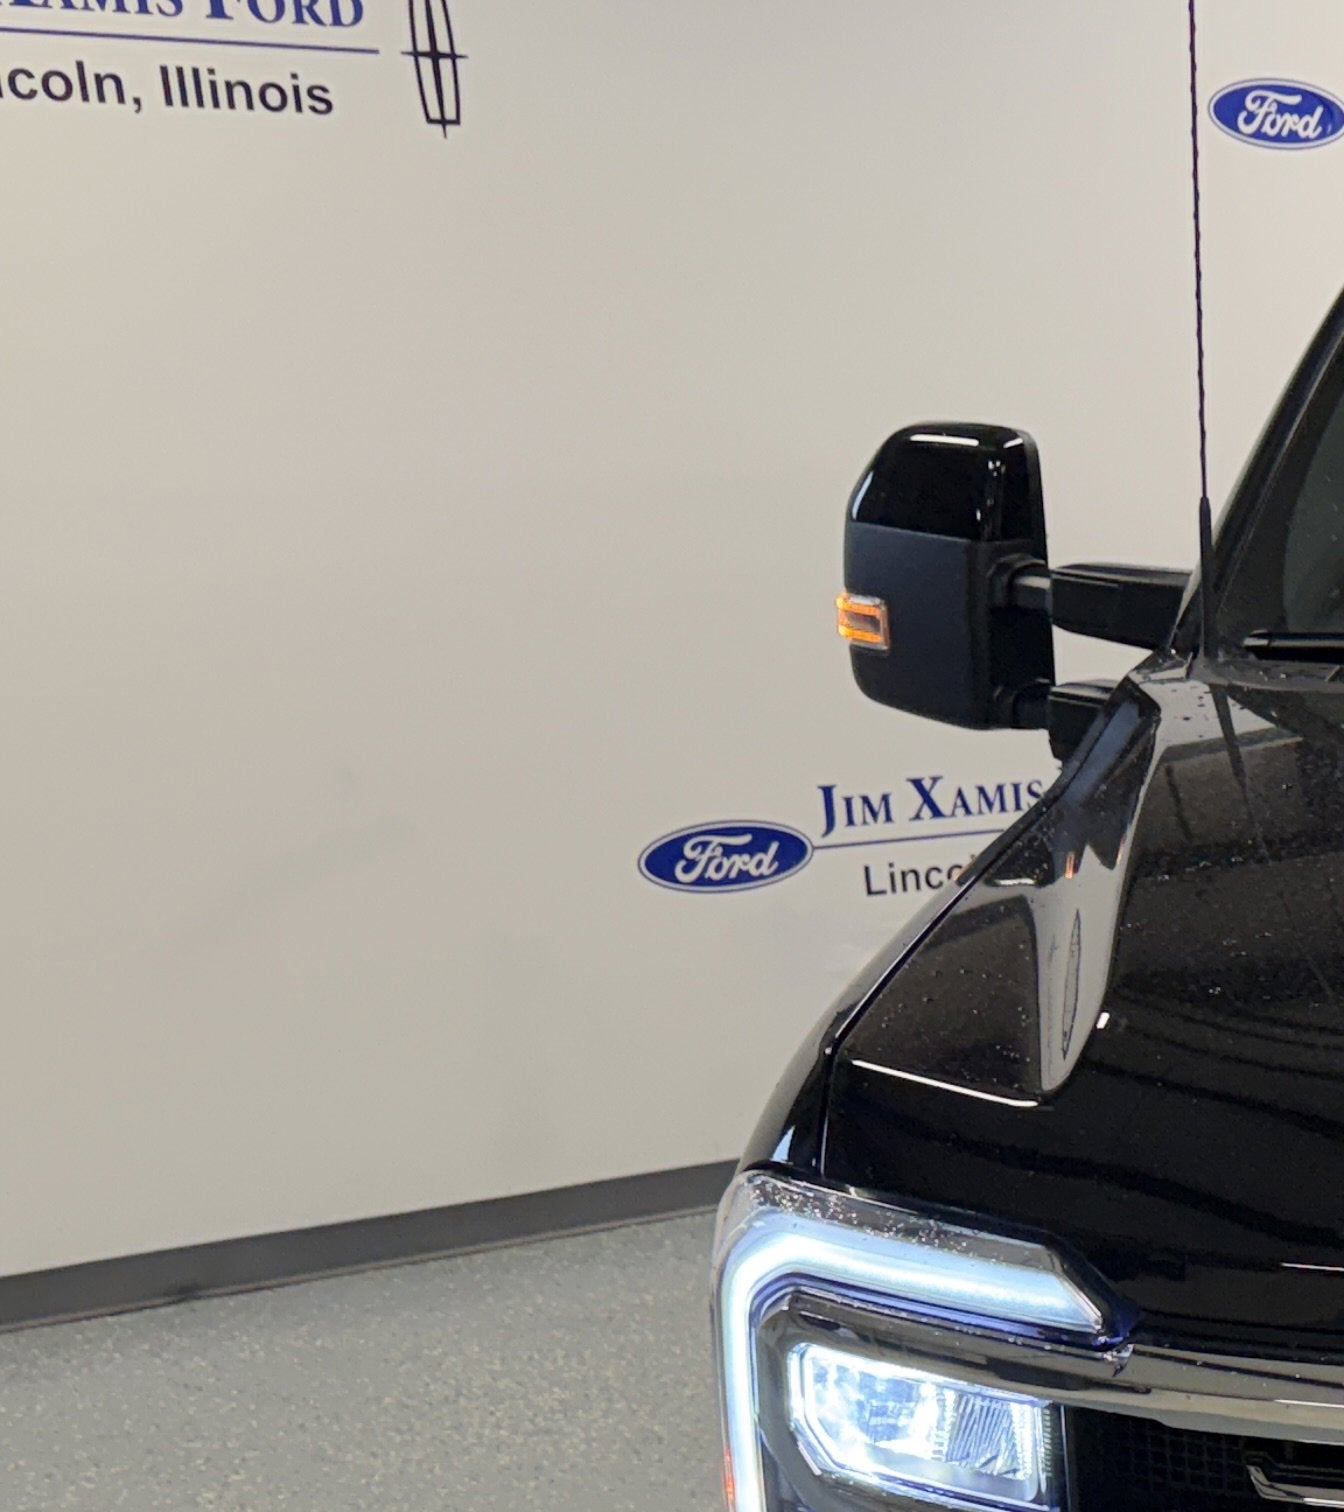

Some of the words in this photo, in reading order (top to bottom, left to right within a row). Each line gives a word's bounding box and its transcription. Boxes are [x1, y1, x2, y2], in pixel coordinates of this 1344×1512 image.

[159, 64, 334, 116] Illinois
[1237, 89, 1323, 140] Ford
[674, 832, 780, 884] Ford
